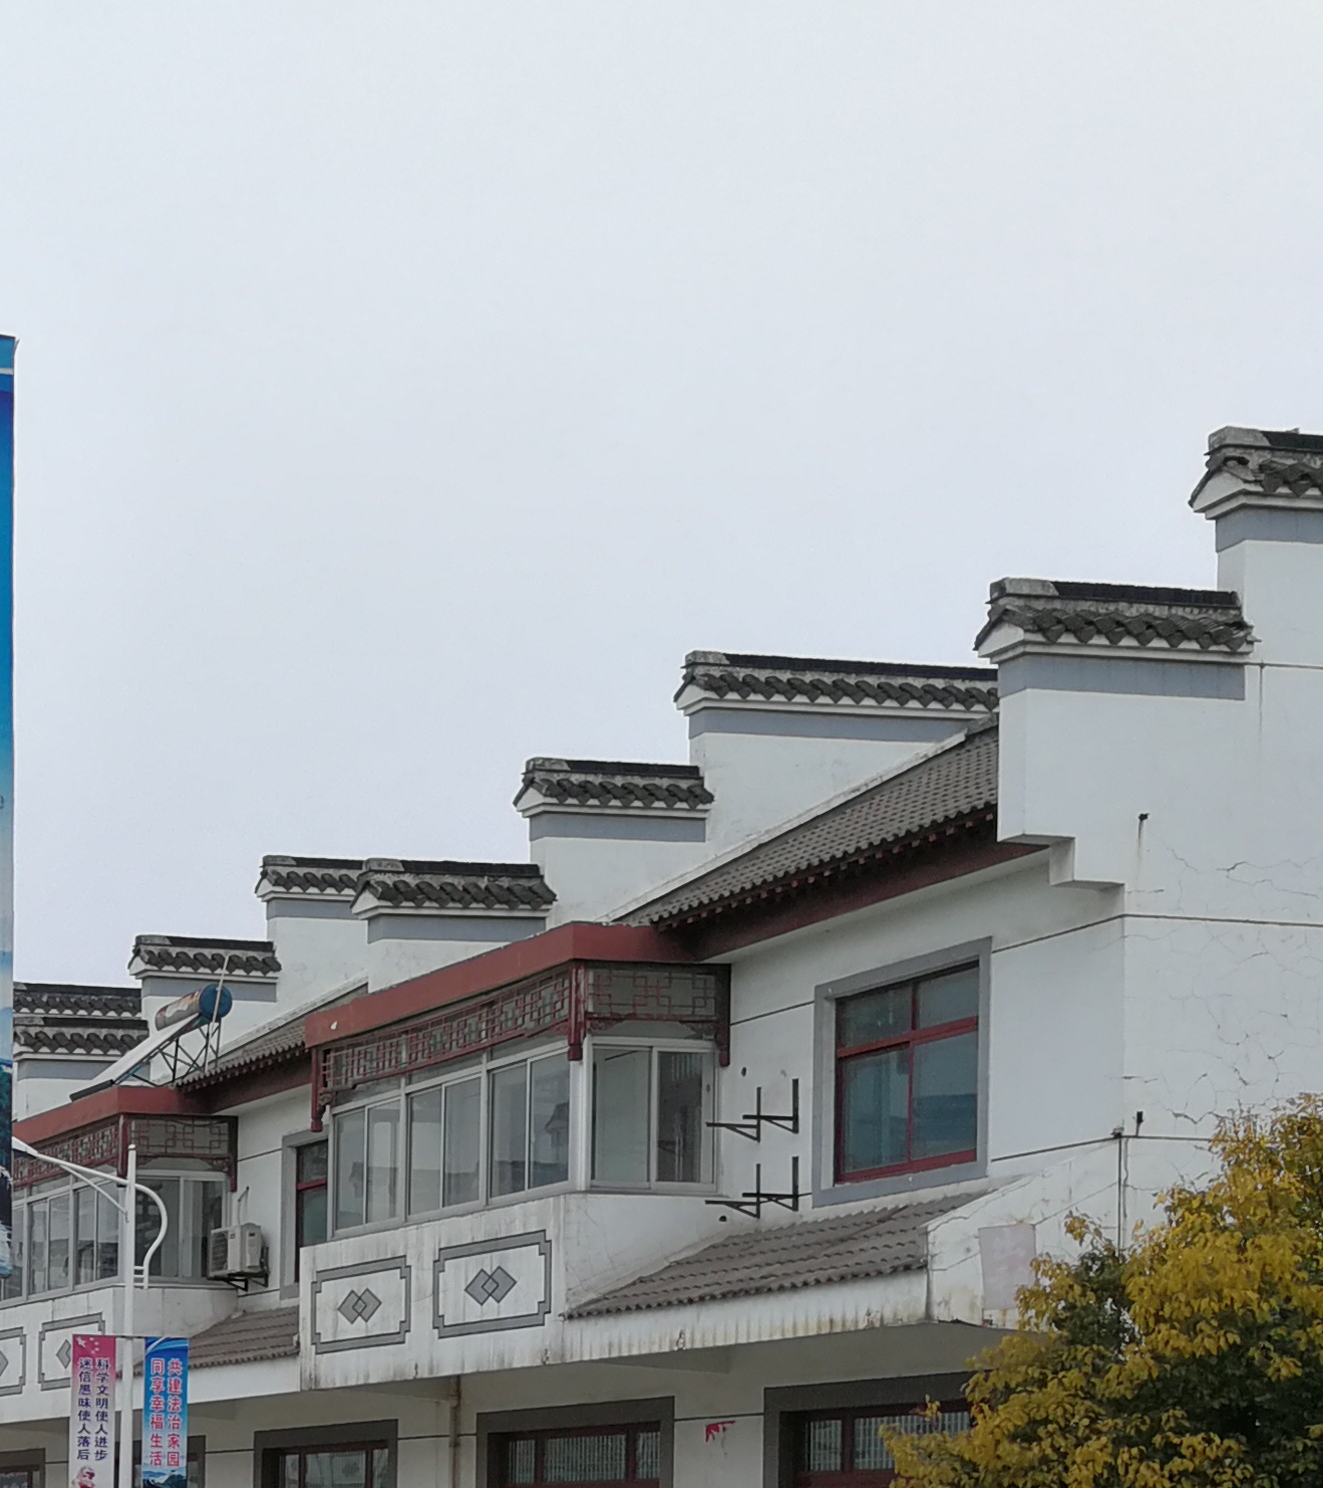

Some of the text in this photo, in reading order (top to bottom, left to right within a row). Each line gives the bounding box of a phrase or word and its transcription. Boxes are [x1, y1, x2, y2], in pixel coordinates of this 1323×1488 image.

[77, 1359, 92, 1460] 迷信愚昧使人落后
[94, 1359, 109, 1460] 科学文明使人进步
[150, 1359, 164, 1467] 同享幸福生活
[167, 1359, 182, 1467] 共建法治家园
